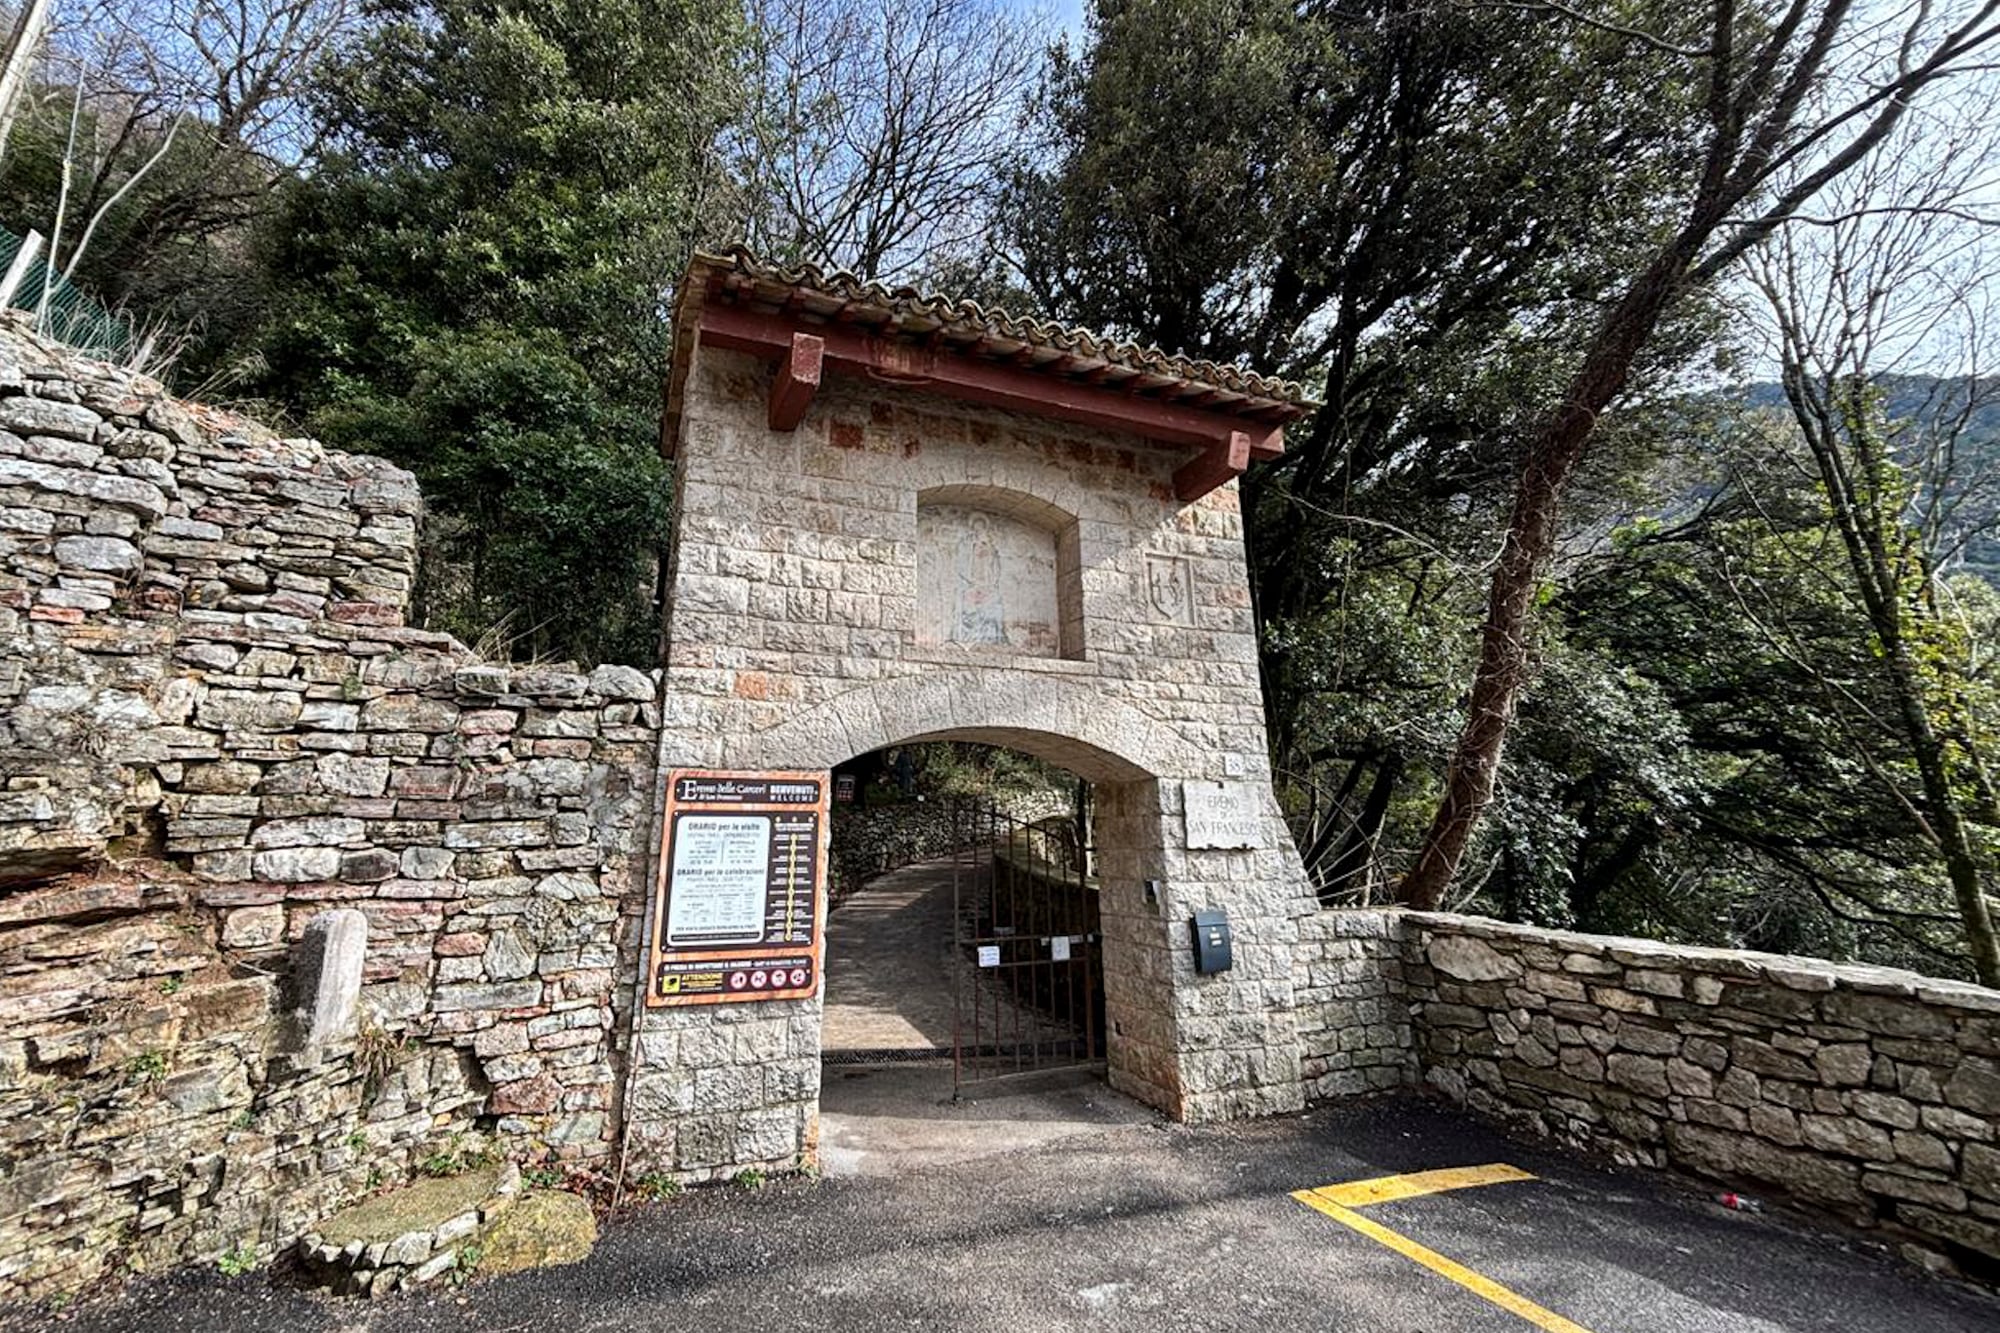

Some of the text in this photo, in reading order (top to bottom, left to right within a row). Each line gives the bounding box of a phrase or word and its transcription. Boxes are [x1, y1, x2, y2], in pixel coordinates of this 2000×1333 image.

[736, 783, 767, 795] Carceri
[770, 785, 814, 794] BENVENUTI
[688, 822, 760, 831] ORARIO per le visite
